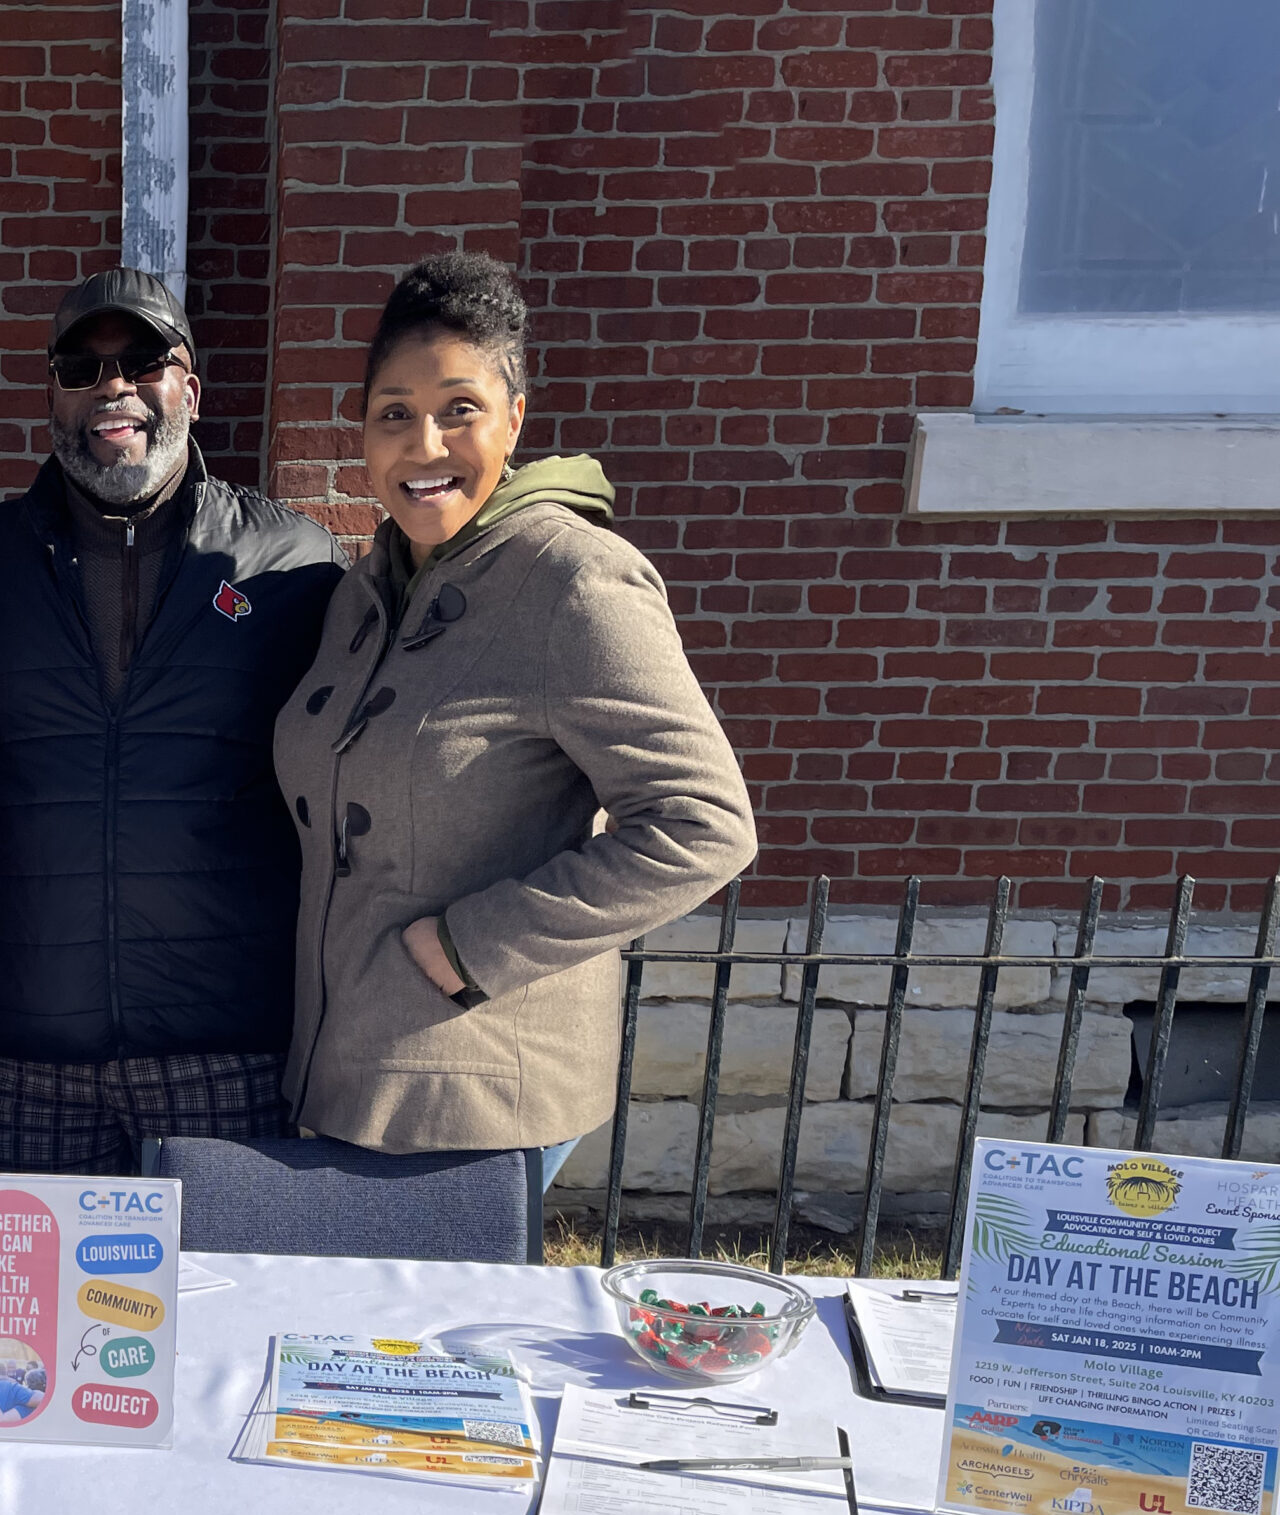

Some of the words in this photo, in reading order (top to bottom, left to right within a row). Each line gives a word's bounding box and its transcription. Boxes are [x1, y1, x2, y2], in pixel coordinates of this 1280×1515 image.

[1107, 1162, 1139, 1173] MOLO
[1141, 1162, 1185, 1179] VILLAGE
[982, 1180, 1023, 1190] ADVANCED
[983, 1173, 1023, 1182] COALITION
[1025, 1176, 1035, 1184] TO
[1036, 1178, 1083, 1188] TRANSFORM
[1206, 1203, 1241, 1217] Event
[1057, 1213, 1099, 1225] LOUISVILLE
[1100, 1217, 1150, 1230] COMMUNITY
[1152, 1222, 1164, 1231] OF
[1165, 1223, 1186, 1234] CARE
[1187, 1225, 1222, 1237] PROJECT
[1064, 1222, 1117, 1235] ADVOCATING
[1118, 1228, 1135, 1236] FOR
[1137, 1229, 1154, 1239] SELF
[1155, 1232, 1162, 1240] &
[1163, 1233, 1189, 1243] LOVED
[1191, 1236, 1215, 1245] ONES
[2, 1234, 33, 1253] CAN
[82, 1243, 157, 1262] LOUISVILLE
[1040, 1233, 1151, 1261] Educational
[1153, 1244, 1226, 1269] Session
[1007, 1253, 1061, 1286] DAY
[1066, 1259, 1104, 1292] AT
[1109, 1265, 1161, 1298] THE
[1168, 1271, 1260, 1309] BEACH
[29, 1297, 40, 1315] A
[86, 1288, 158, 1319] COMMUNITY
[990, 1285, 1002, 1294] At
[1004, 1288, 1020, 1296] our
[1022, 1287, 1058, 1301] themed
[1060, 1292, 1079, 1305] day
[1081, 1296, 1092, 1304] at
[1094, 1297, 1109, 1306] the
[1111, 1299, 1144, 1312] Beach,
[1148, 1303, 1173, 1314] there
[1176, 1306, 1193, 1316] will
[1196, 1308, 1209, 1318] be
[1212, 1310, 1269, 1327] Community
[1000, 1297, 1035, 1311] Experts
[1037, 1302, 1047, 1311] to
[1050, 1303, 1076, 1315] share
[1078, 1306, 1093, 1317] life
[1096, 1309, 1142, 1323] changing
[1146, 1316, 1201, 1330] information
[1204, 1323, 1216, 1331] on
[1220, 1322, 1242, 1334] how
[1245, 1327, 1254, 1336] to
[102, 1327, 111, 1336] OF
[981, 1306, 1025, 1320] advocate
[1027, 1310, 1040, 1321] for
[1044, 1313, 1060, 1324] self
[1062, 1316, 1081, 1327] and
[1084, 1319, 1110, 1331] loved
[1113, 1324, 1136, 1334] ones
[1139, 1325, 1166, 1337] when
[1168, 1330, 1233, 1347] experiencing
[1051, 1332, 1070, 1343] SAT
[1071, 1335, 1092, 1346] JAN
[1094, 1338, 1110, 1350] 18,
[1112, 1340, 1137, 1352] 2025
[1149, 1344, 1202, 1360] 10AM-2PM
[107, 1345, 150, 1369] CARE
[308, 1362, 346, 1372] DAY
[351, 1364, 377, 1375] AT
[381, 1367, 420, 1378] THE
[425, 1368, 491, 1381] BEACH
[1083, 1359, 1117, 1372] Molo
[1119, 1364, 1164, 1379] Village
[974, 1361, 999, 1371] 1219
[1002, 1364, 1014, 1374] W.
[1016, 1367, 1068, 1380] Jefferson
[1070, 1373, 1107, 1387] Street,
[1109, 1378, 1137, 1390] Suite
[1138, 1382, 1160, 1392] 204
[1163, 1386, 1219, 1402] Louisville,
[1221, 1391, 1236, 1403] KY
[1238, 1395, 1275, 1408] 40203
[81, 1390, 150, 1416] PROJECT
[970, 1374, 994, 1384] FOOD
[1003, 1379, 1021, 1388] FUN
[1030, 1383, 1078, 1395] FRIENDSHIP
[1087, 1390, 1129, 1403] THRILLING
[1131, 1396, 1162, 1407] BINGO
[1163, 1401, 1197, 1412] ACTION
[1207, 1406, 1236, 1417] PRIZES
[987, 1399, 1029, 1412] Partners:
[1038, 1394, 1053, 1404] LIFE
[1055, 1397, 1104, 1411] CHANGING
[1106, 1404, 1168, 1420] INFORMATION
[965, 1411, 1019, 1427] AARP
[1186, 1416, 1220, 1428] Limited
[1221, 1420, 1254, 1433] Seating
[1256, 1425, 1278, 1435] Scan
[1186, 1427, 1200, 1436] QR
[1202, 1429, 1225, 1438] Code
[1227, 1431, 1237, 1440] to
[1239, 1434, 1275, 1446] Register
[961, 1459, 1031, 1476] ARCHANGELS
[1059, 1469, 1109, 1486] Chrysalis
[975, 1486, 1033, 1502] CenterWell
[1138, 1492, 1173, 1515] UL
[1052, 1497, 1105, 1515] KIPDA
